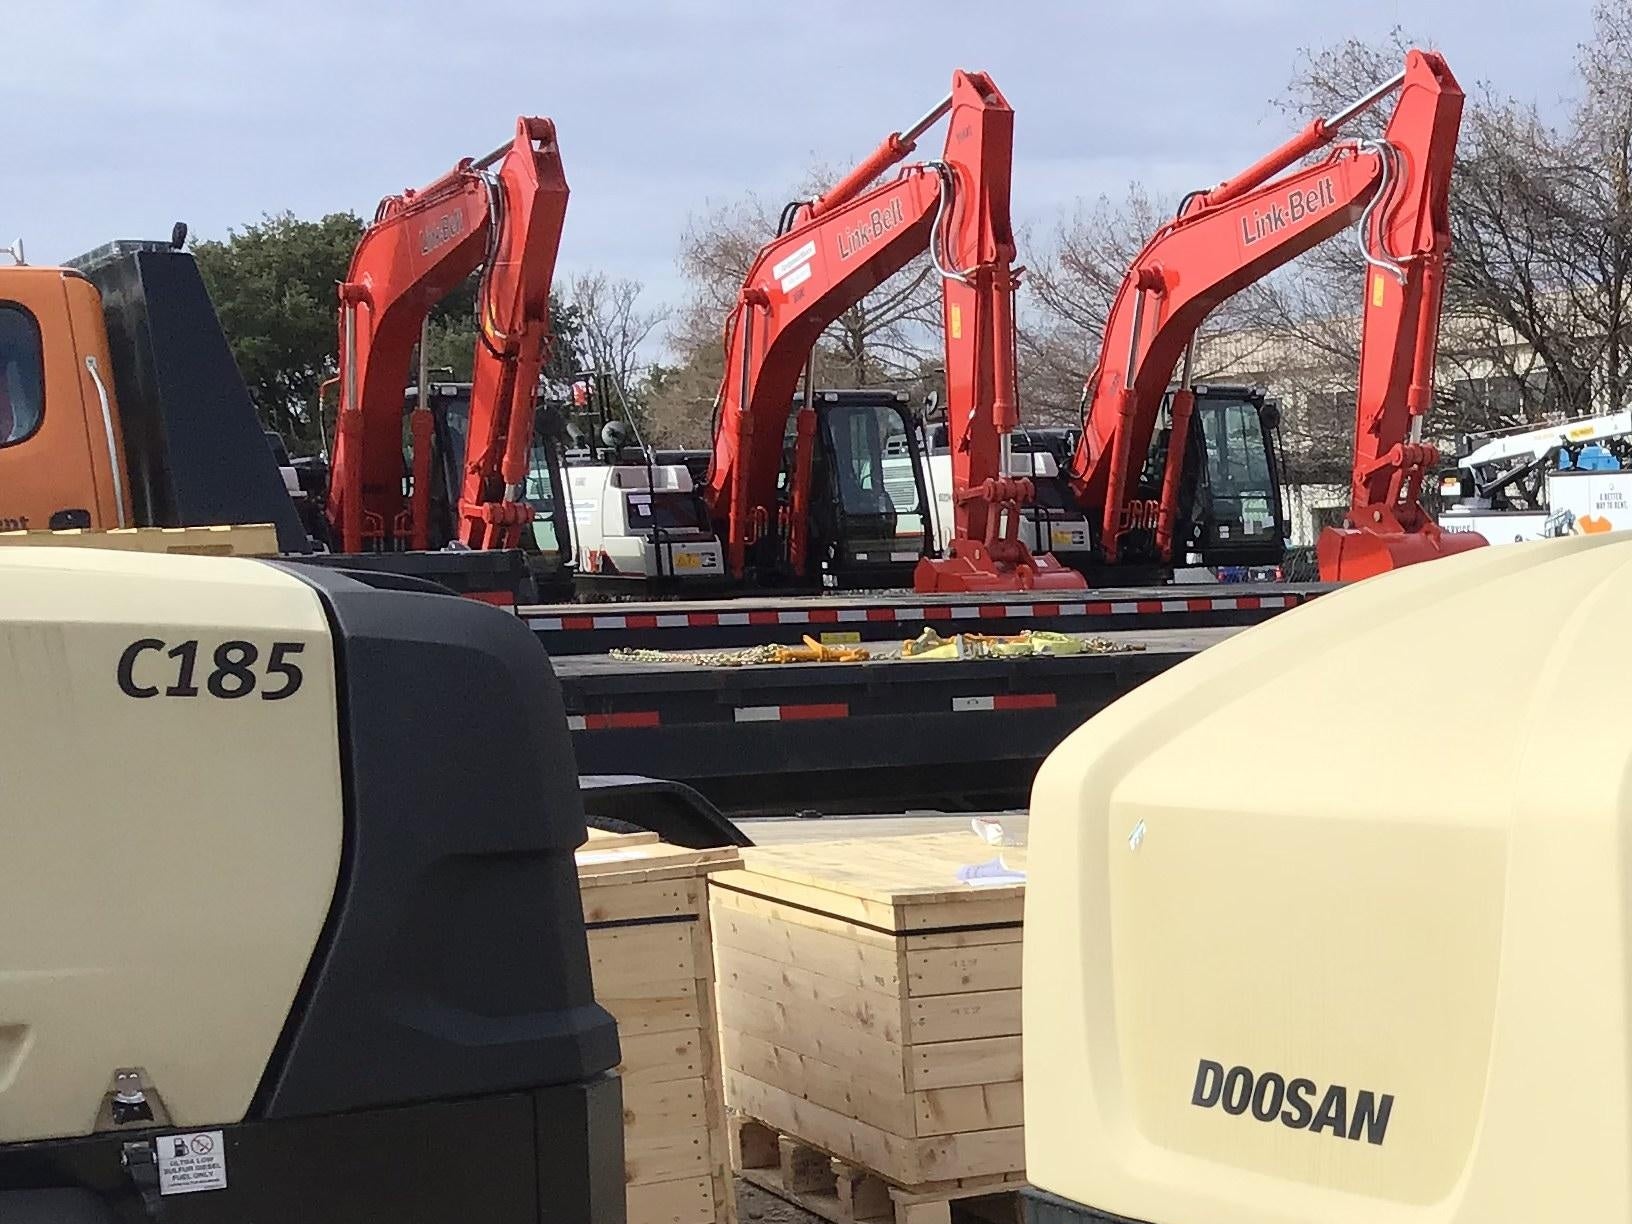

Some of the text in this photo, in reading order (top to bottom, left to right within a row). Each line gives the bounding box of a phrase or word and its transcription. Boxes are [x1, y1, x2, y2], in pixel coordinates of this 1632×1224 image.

[837, 198, 904, 260] Link-Belt
[1241, 177, 1336, 246] Link-Belt
[117, 639, 305, 700] C185
[1191, 1058, 1395, 1146] DOOSAN
